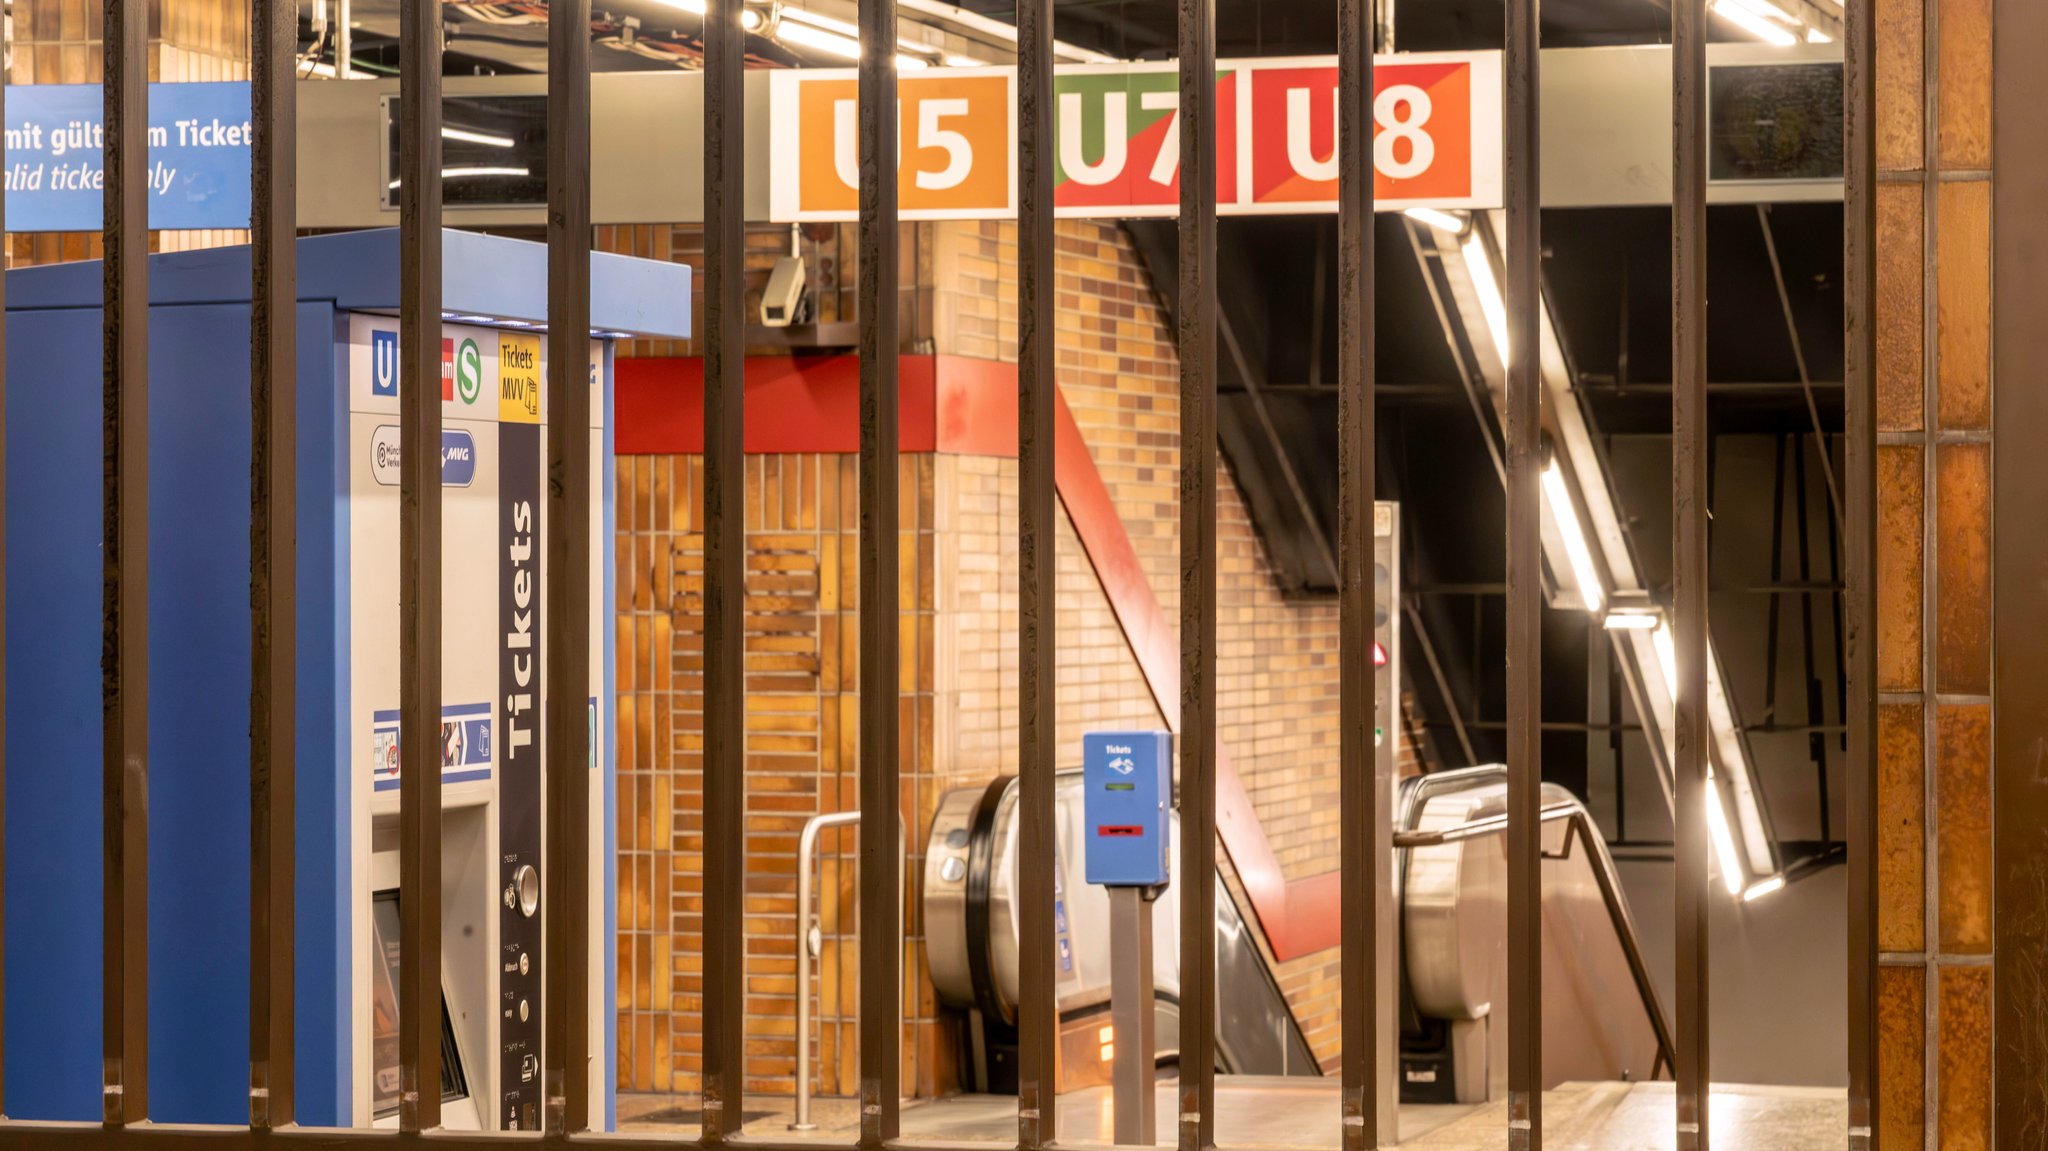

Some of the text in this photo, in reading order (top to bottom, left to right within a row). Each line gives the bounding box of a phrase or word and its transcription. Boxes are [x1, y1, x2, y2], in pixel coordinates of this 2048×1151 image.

[5, 121, 42, 150] mit
[51, 120, 168, 156] gültm
[1059, 91, 1180, 187] U7
[1287, 84, 1435, 181] U8
[377, 338, 393, 388] U
[461, 344, 478, 400] S
[502, 344, 533, 369] Tickets
[502, 376, 524, 401] MVV
[447, 447, 469, 461] MVG
[507, 500, 531, 759] Tickets
